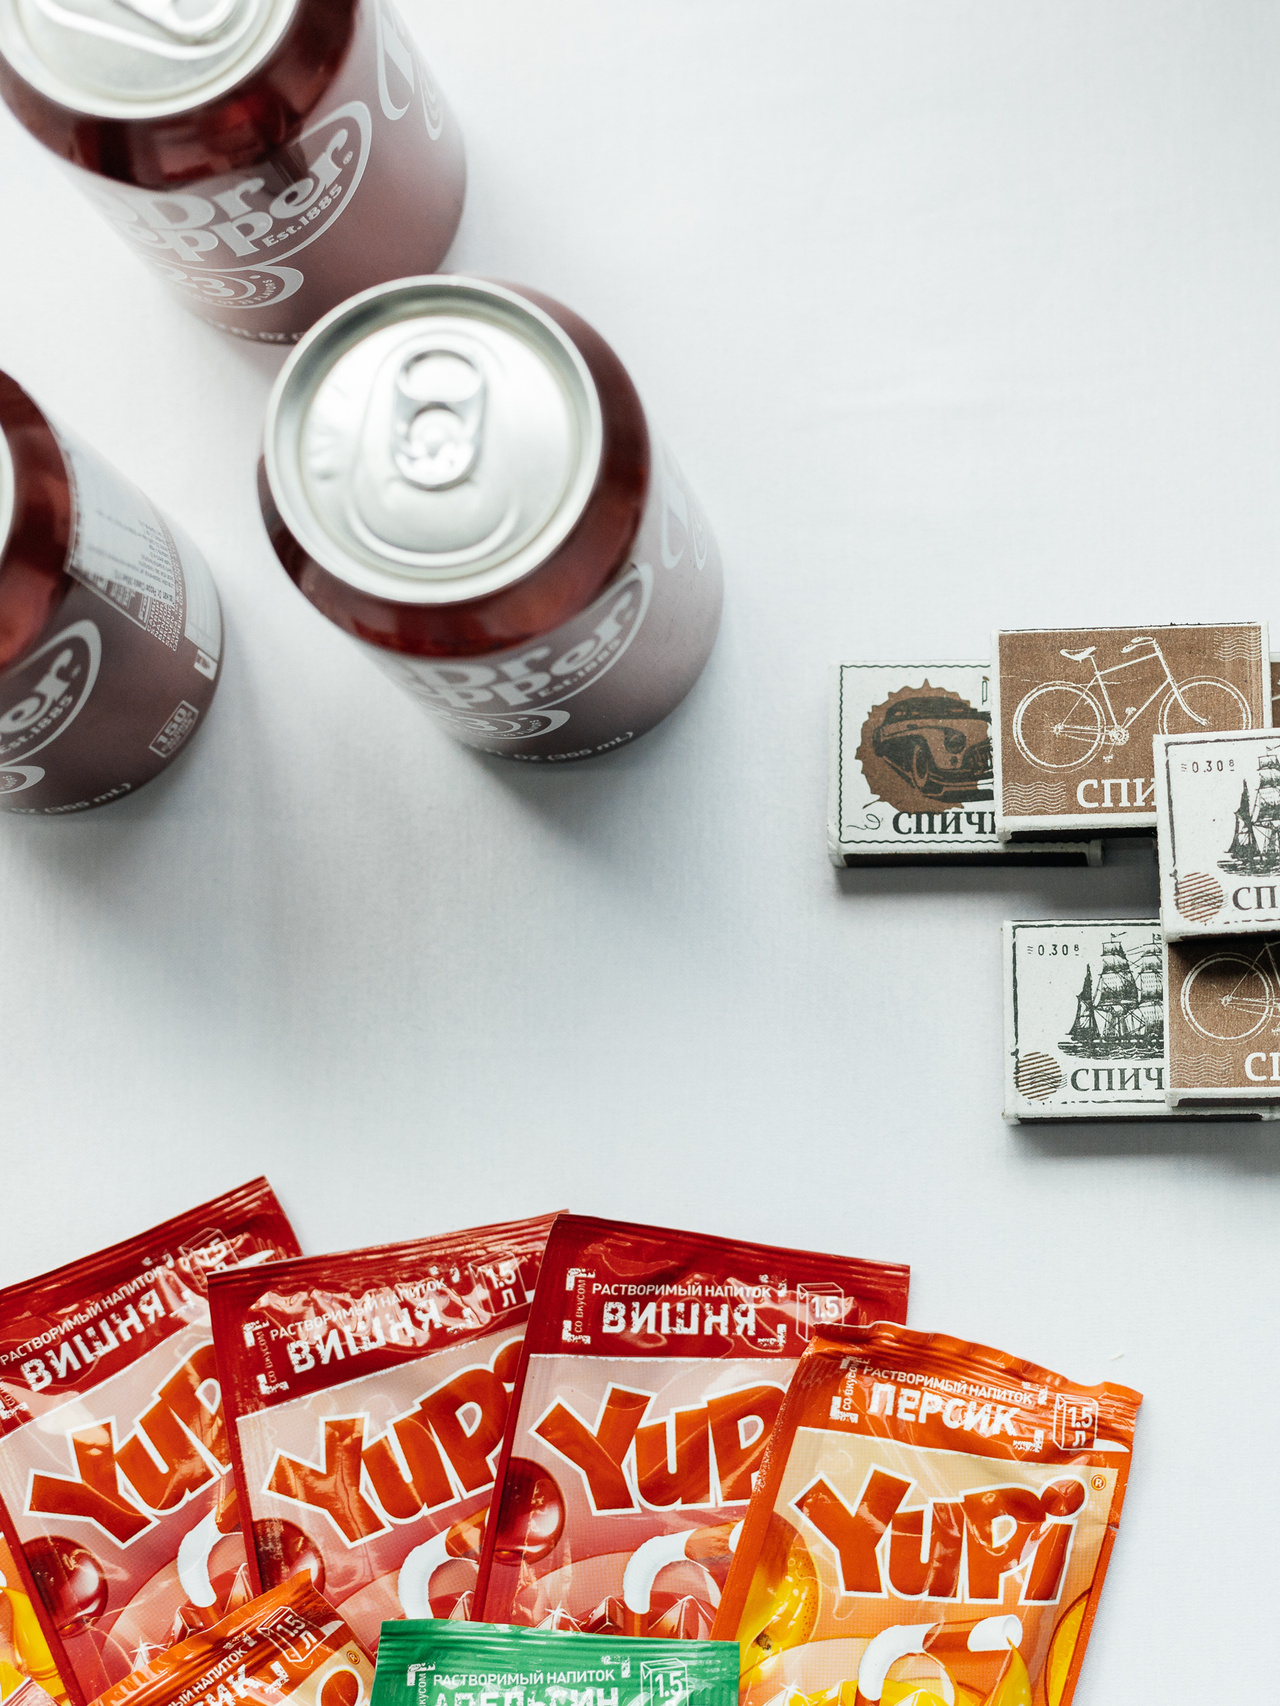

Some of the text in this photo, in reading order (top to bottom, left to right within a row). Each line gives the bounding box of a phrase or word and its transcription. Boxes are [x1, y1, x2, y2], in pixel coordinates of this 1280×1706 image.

[404, 591, 632, 709] epper
[1076, 778, 1156, 808] СПИ
[893, 811, 996, 835] СПИЧ
[1070, 1067, 1165, 1092] СПИЧ
[592, 1281, 772, 1299] РАСТВОРИМЫЙ НАПИТОК
[811, 1296, 840, 1318] 1.5
[0, 1265, 164, 1366] РАСТВОРИМЫЙ НАПИТОК
[270, 1278, 447, 1341] РАСТВОРИМЫЙ НАПИТОК
[602, 1301, 756, 1335] ВИШНЯ
[20, 1288, 166, 1392] ВИШНЯ
[287, 1299, 443, 1374] ВИШНЯ
[862, 1365, 1034, 1405] РАСТВОРИМЫЙ НАПИТОК
[867, 1382, 1020, 1436] ПЕРСИК
[1067, 1407, 1093, 1428] 1.5
[192, 1646, 249, 1694] НАПИТОК
[433, 1669, 616, 1686] РАСТВОРИМЫЙ НАПИТОК
